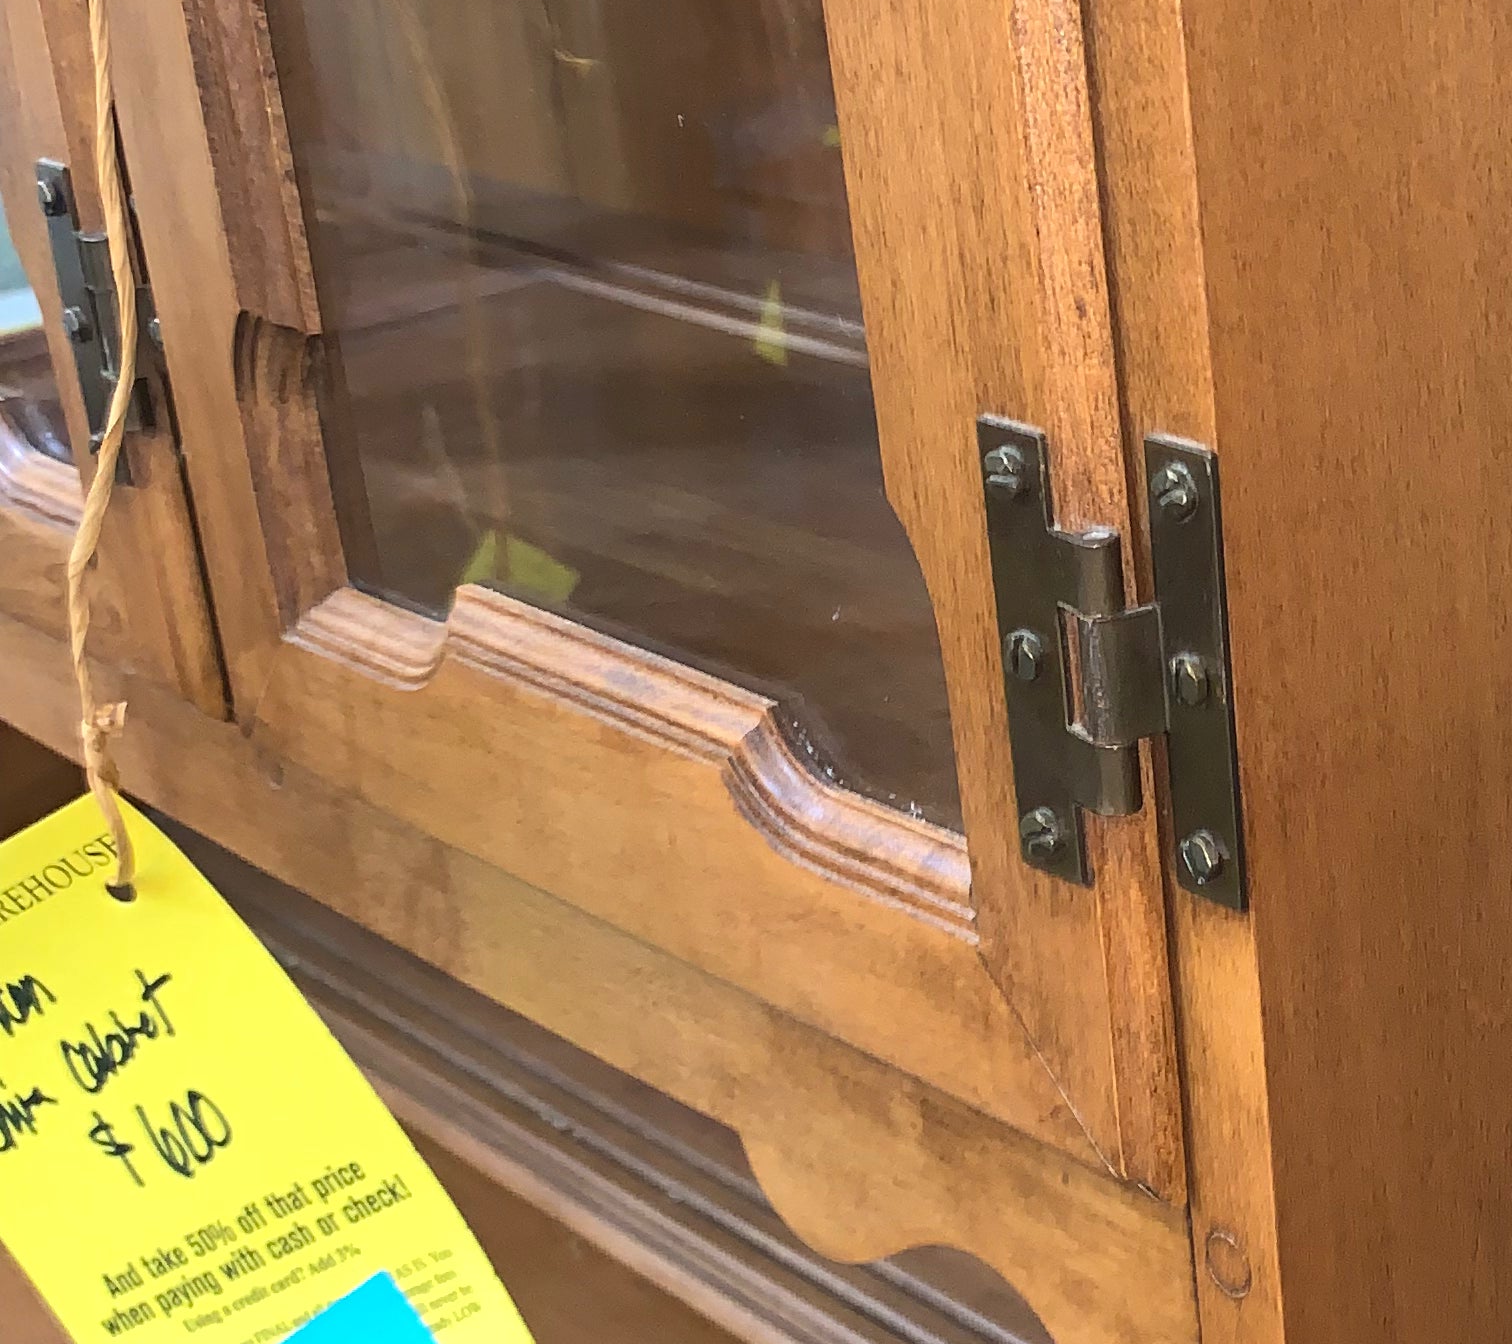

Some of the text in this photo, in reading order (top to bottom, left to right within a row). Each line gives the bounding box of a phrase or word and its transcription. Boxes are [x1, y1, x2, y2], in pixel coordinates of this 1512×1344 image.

[101, 1174, 412, 1337] when paying with cash or check!
[102, 1161, 366, 1299] And take 50% off that price
[232, 1286, 270, 1312] credit
[308, 1253, 336, 1275] Add
